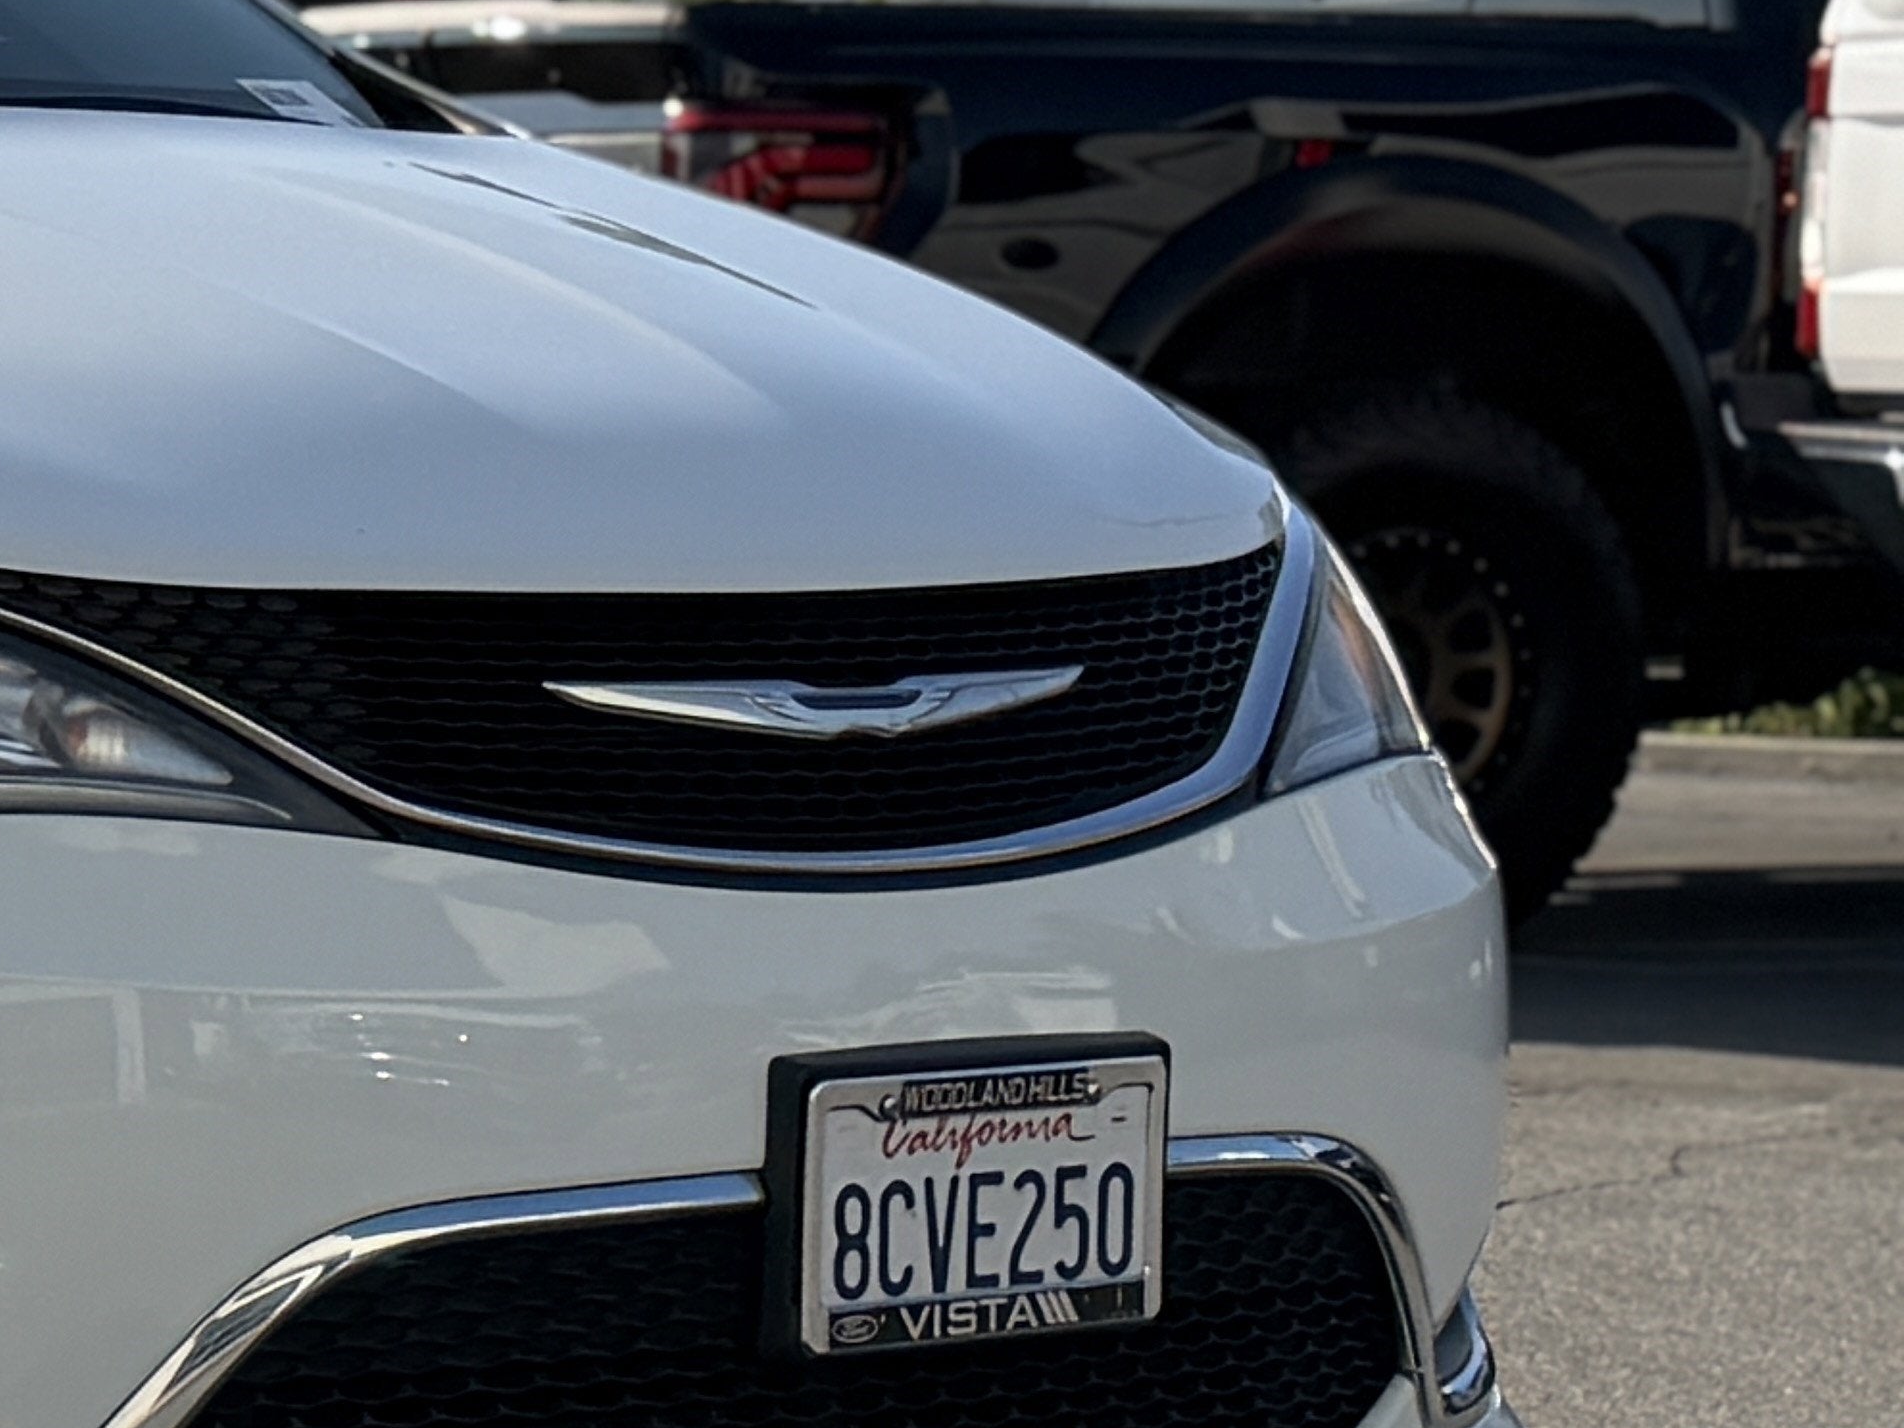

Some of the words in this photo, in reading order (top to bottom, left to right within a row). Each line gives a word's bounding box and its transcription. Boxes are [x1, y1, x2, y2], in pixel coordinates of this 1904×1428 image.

[882, 1111, 1096, 1170] California
[833, 1160, 1135, 1301] 8CVE250
[899, 1293, 1040, 1340] VISTA
